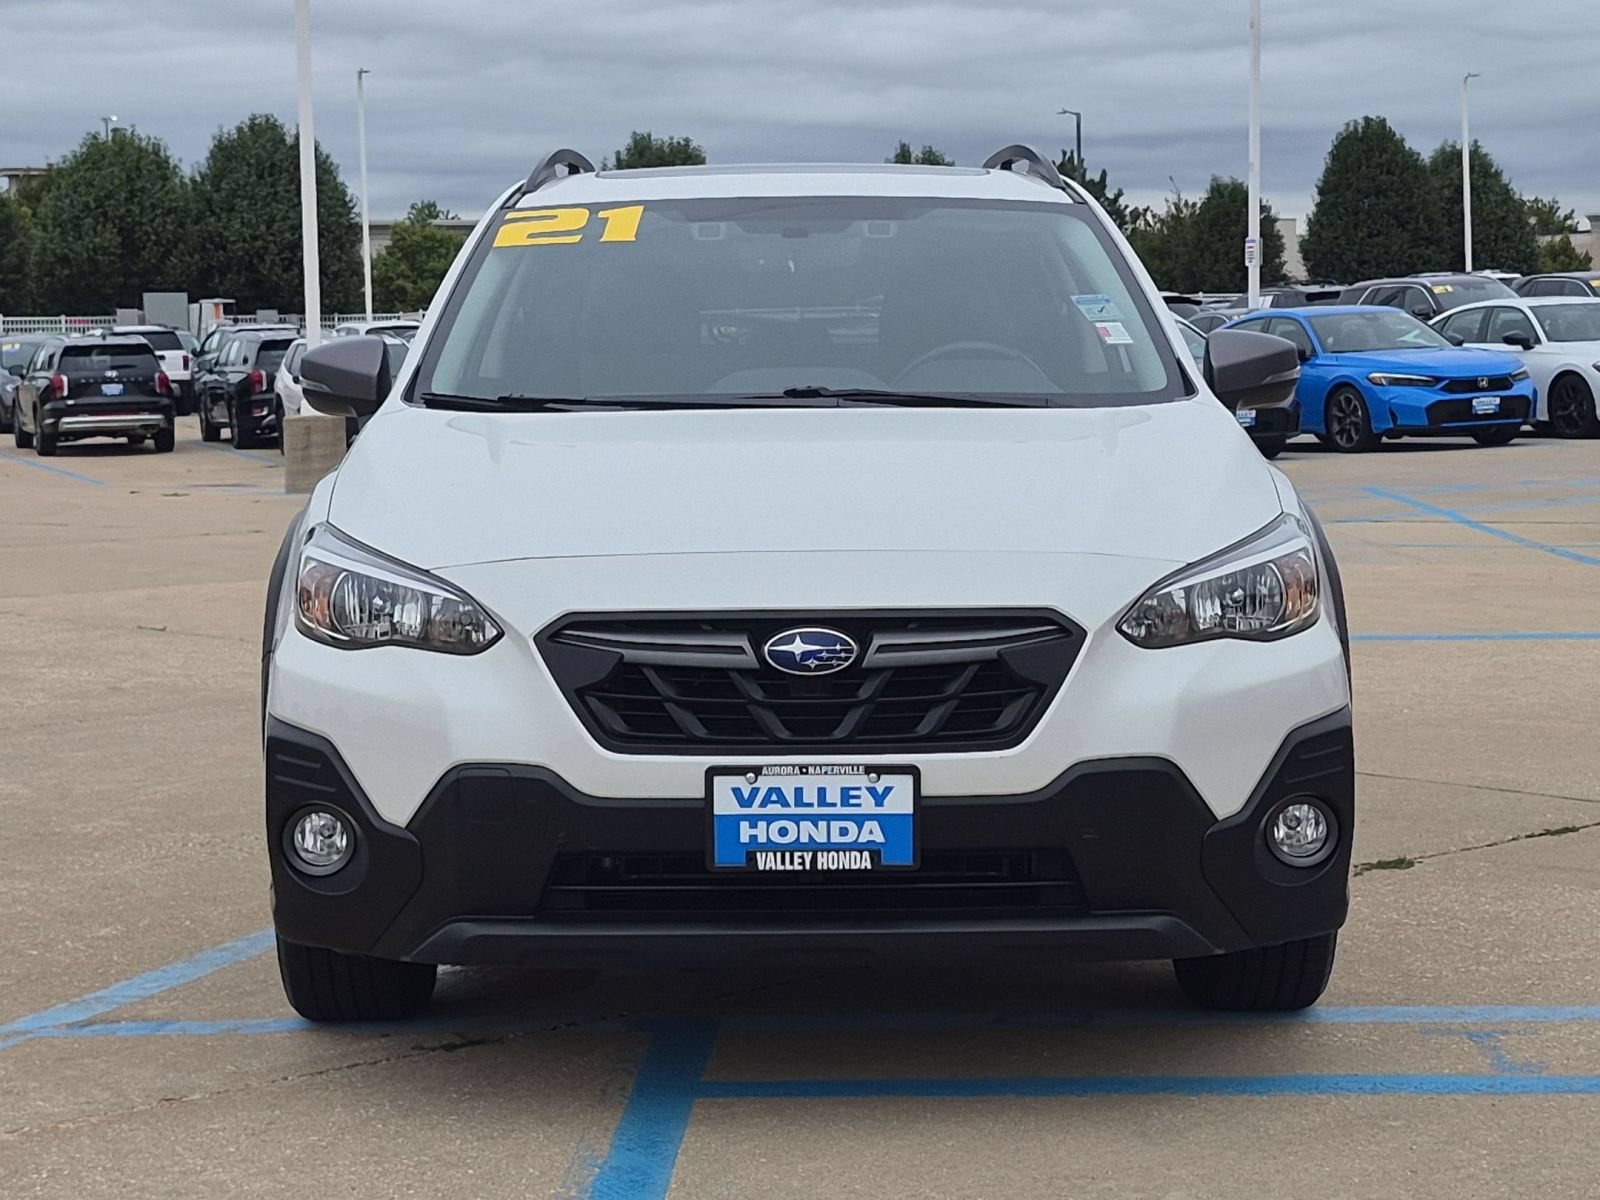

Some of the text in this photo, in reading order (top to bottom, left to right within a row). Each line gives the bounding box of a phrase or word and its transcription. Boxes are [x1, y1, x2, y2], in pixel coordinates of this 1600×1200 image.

[493, 205, 644, 248] 21
[762, 764, 865, 775] AURORA NAPERVILLE
[731, 786, 894, 808] VALLEY
[739, 820, 886, 844] HONDA
[756, 850, 872, 871] VALLEY HONDA
